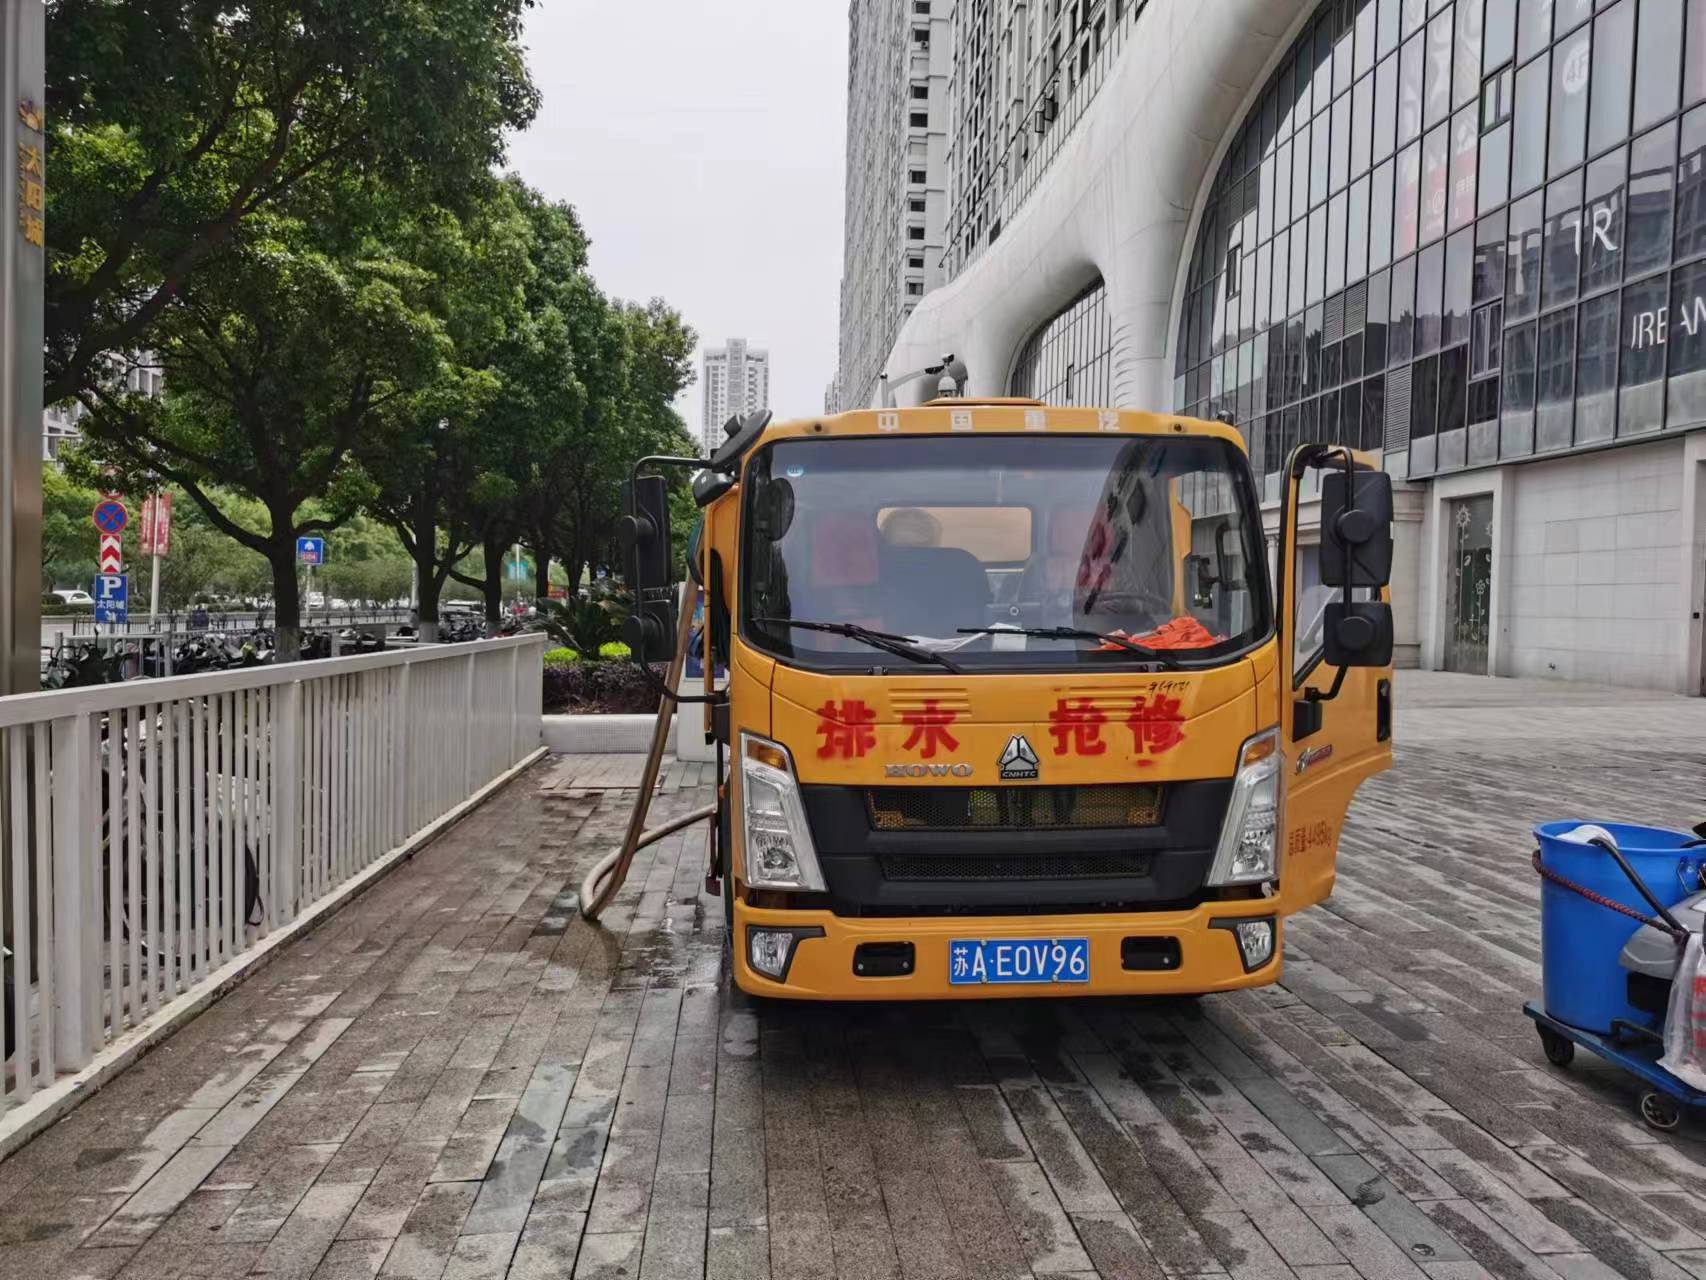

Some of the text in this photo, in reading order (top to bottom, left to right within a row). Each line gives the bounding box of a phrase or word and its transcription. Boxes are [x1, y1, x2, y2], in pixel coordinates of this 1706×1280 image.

[100, 576, 122, 598] P
[885, 764, 973, 778] HOWO
[1002, 770, 1037, 778] CNHTC
